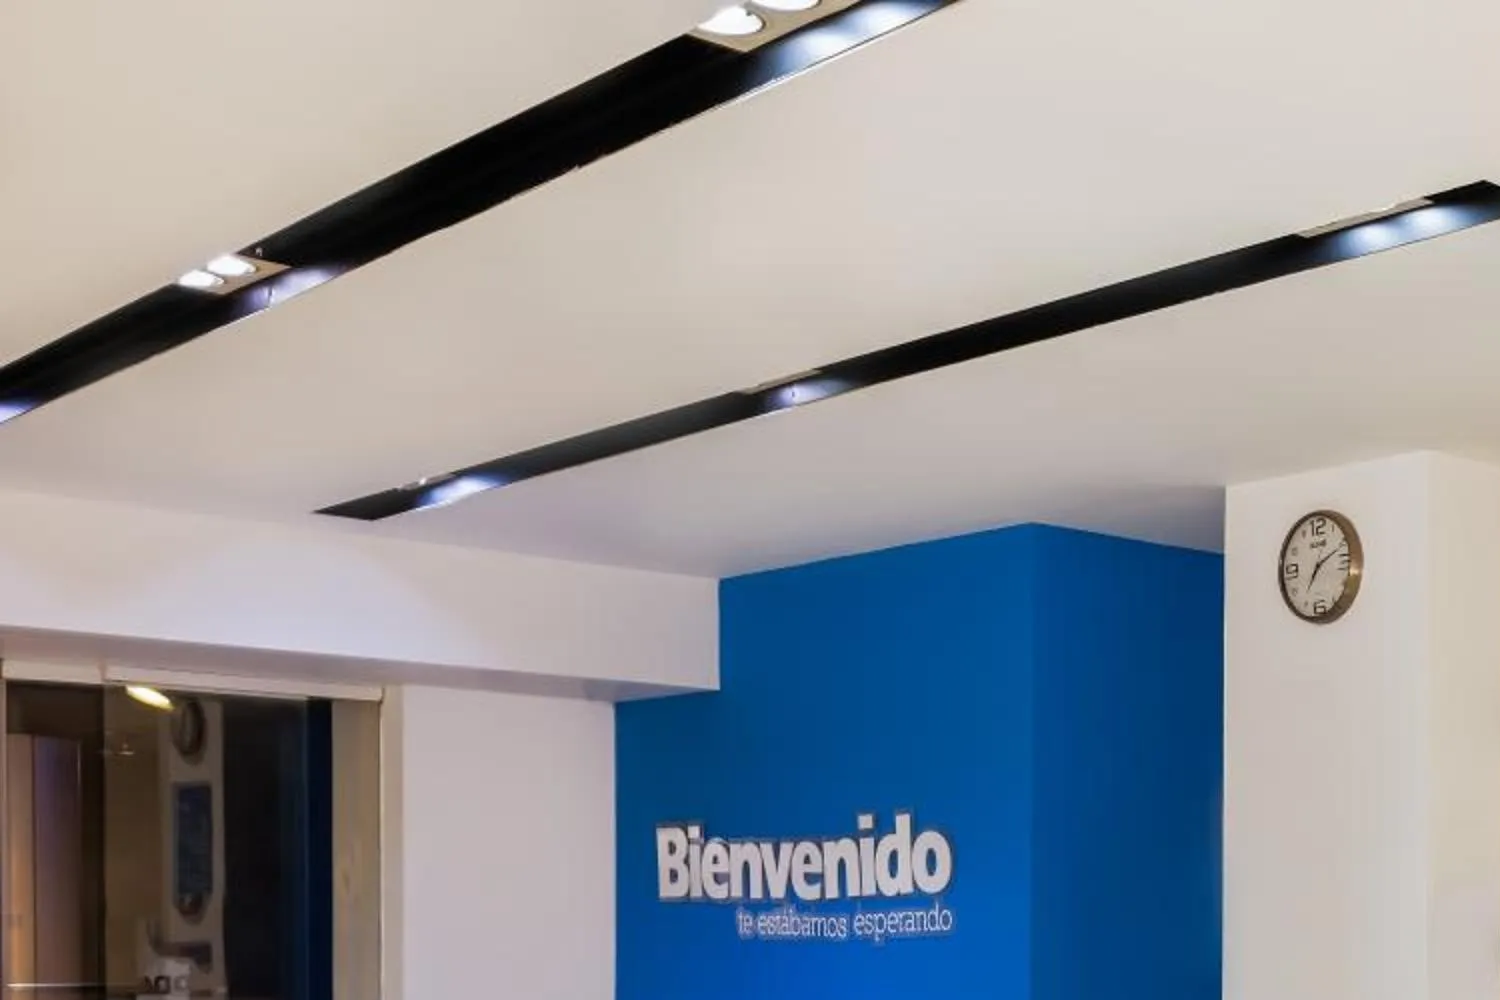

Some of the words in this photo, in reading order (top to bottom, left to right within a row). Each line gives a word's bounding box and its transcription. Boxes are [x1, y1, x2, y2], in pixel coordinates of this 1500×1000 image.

[1310, 518, 1327, 536] 12
[1313, 599, 1327, 615] 6
[656, 811, 953, 901] Bienvenido
[738, 910, 752, 934] te
[757, 906, 847, 938] estábamos
[853, 902, 953, 942] esperando
